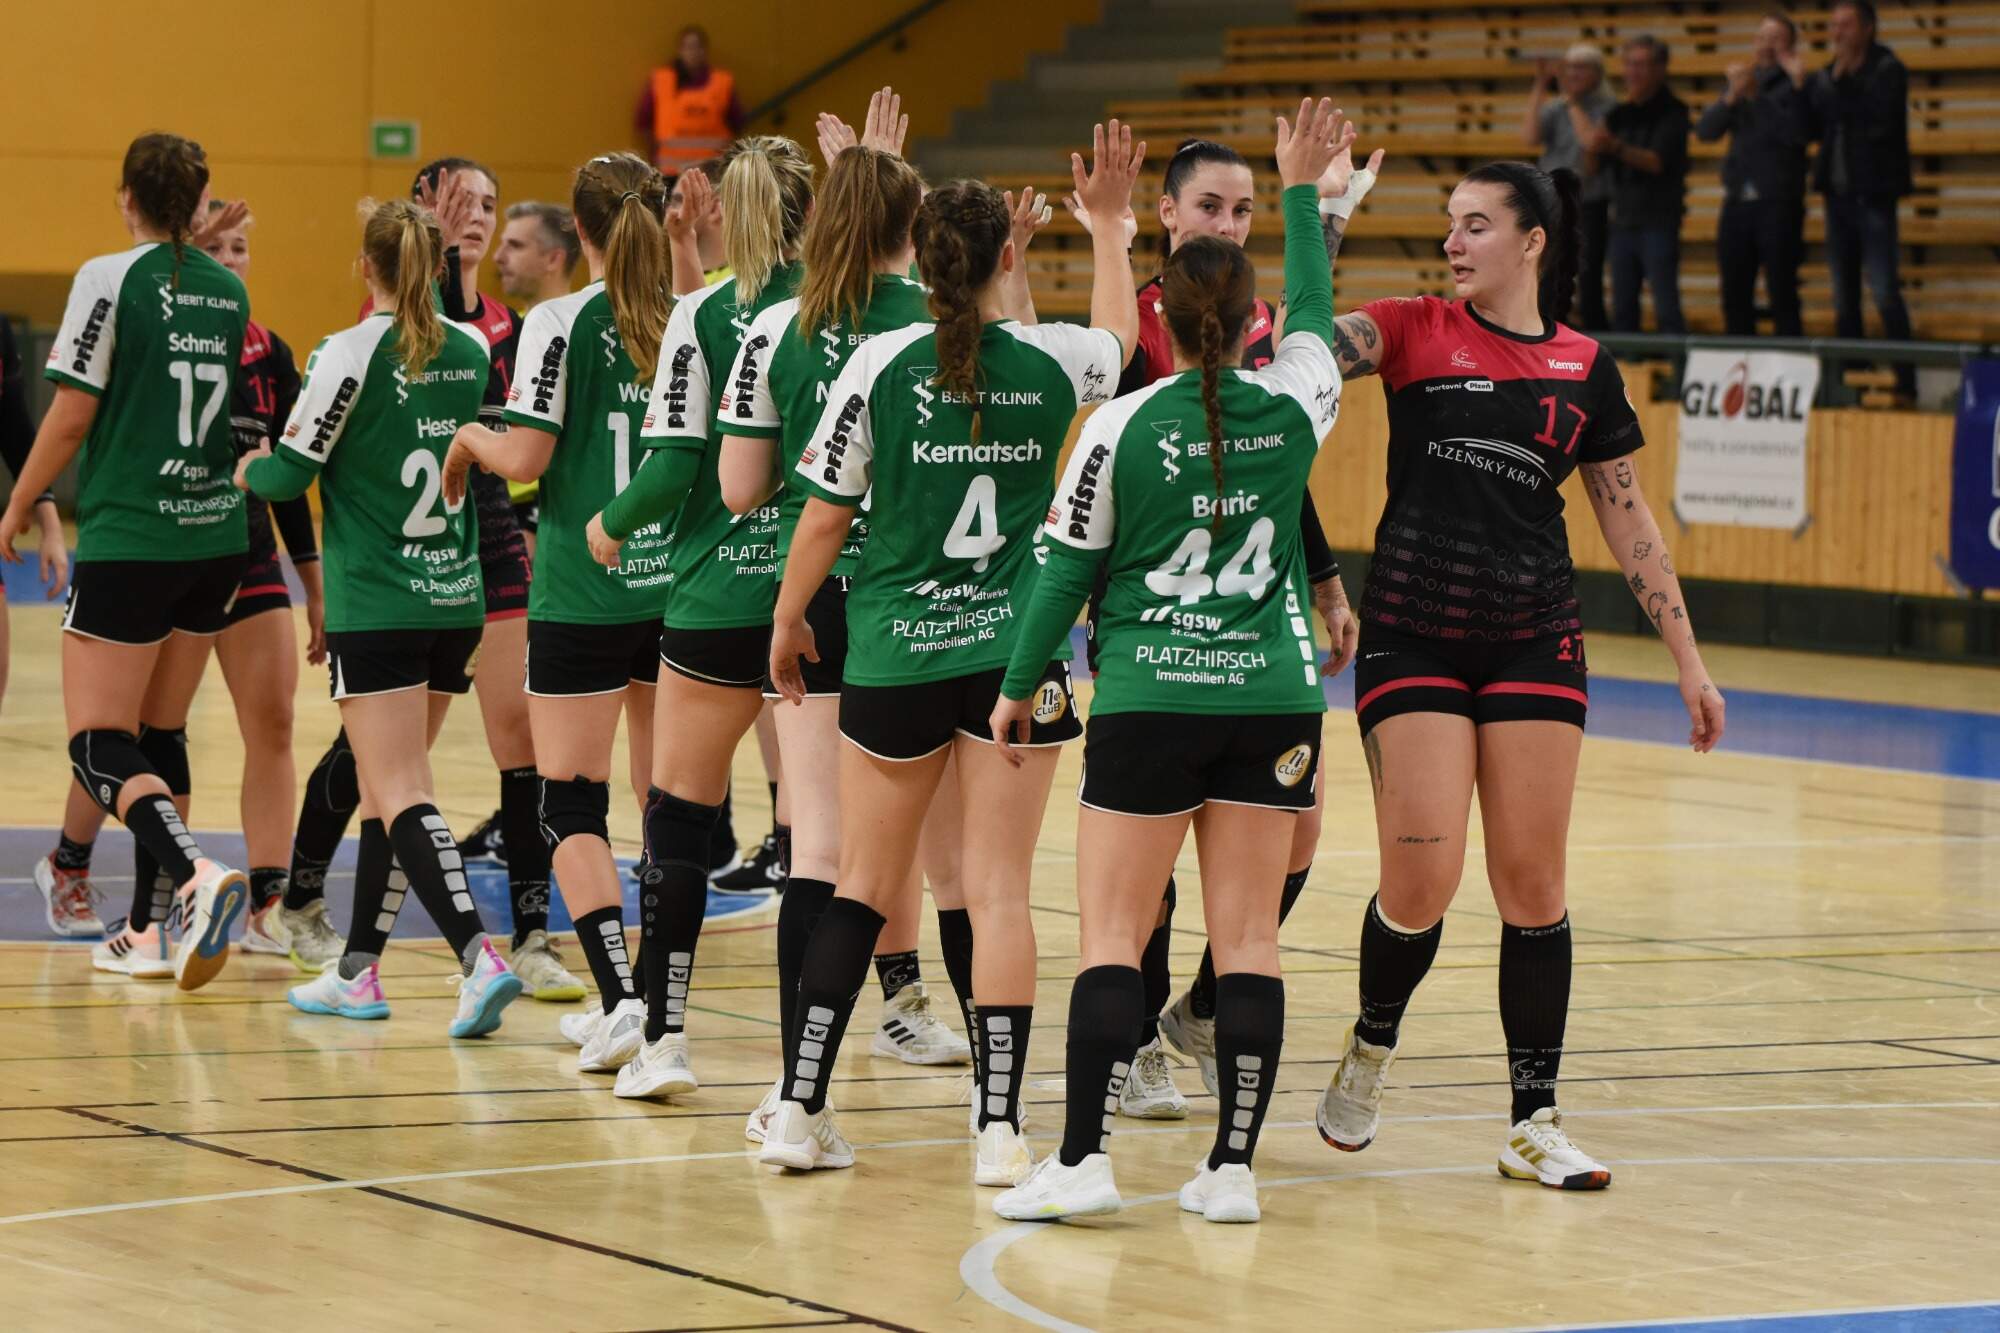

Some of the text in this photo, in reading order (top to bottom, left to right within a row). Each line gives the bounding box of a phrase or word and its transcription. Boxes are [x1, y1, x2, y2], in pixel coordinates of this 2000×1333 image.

[176, 294, 240, 313] BERIT KLINIK
[168, 332, 228, 356] Schmid
[443, 369, 478, 382] KLINIK
[1548, 359, 1584, 373] Kempa
[618, 382, 651, 403] Wo
[991, 391, 1043, 405] KLINIK
[1425, 382, 1462, 393] Sportovní
[169, 361, 228, 448] 17
[416, 416, 457, 439] Hess
[1534, 395, 1588, 455] 17
[912, 438, 1042, 464] Kernatsch
[1187, 433, 1286, 457] BET KLINIK
[1427, 441, 1541, 491] PLZEŇSKÝ KRAJ
[400, 448, 466, 539] 2
[1192, 489, 1260, 518] Baric
[943, 474, 1007, 573] 4
[422, 547, 459, 565] sgsw
[1145, 516, 1277, 606] 44
[735, 563, 780, 575] Immobi
[931, 584, 979, 600] sgsw
[892, 602, 1014, 639] PLATZHIRSCH
[1171, 611, 1222, 632] sgsw
[910, 627, 996, 653] Immobilien AG
[1135, 645, 1267, 669] PLATZHIRSCH
[1155, 669, 1245, 685] Immobilien AG
